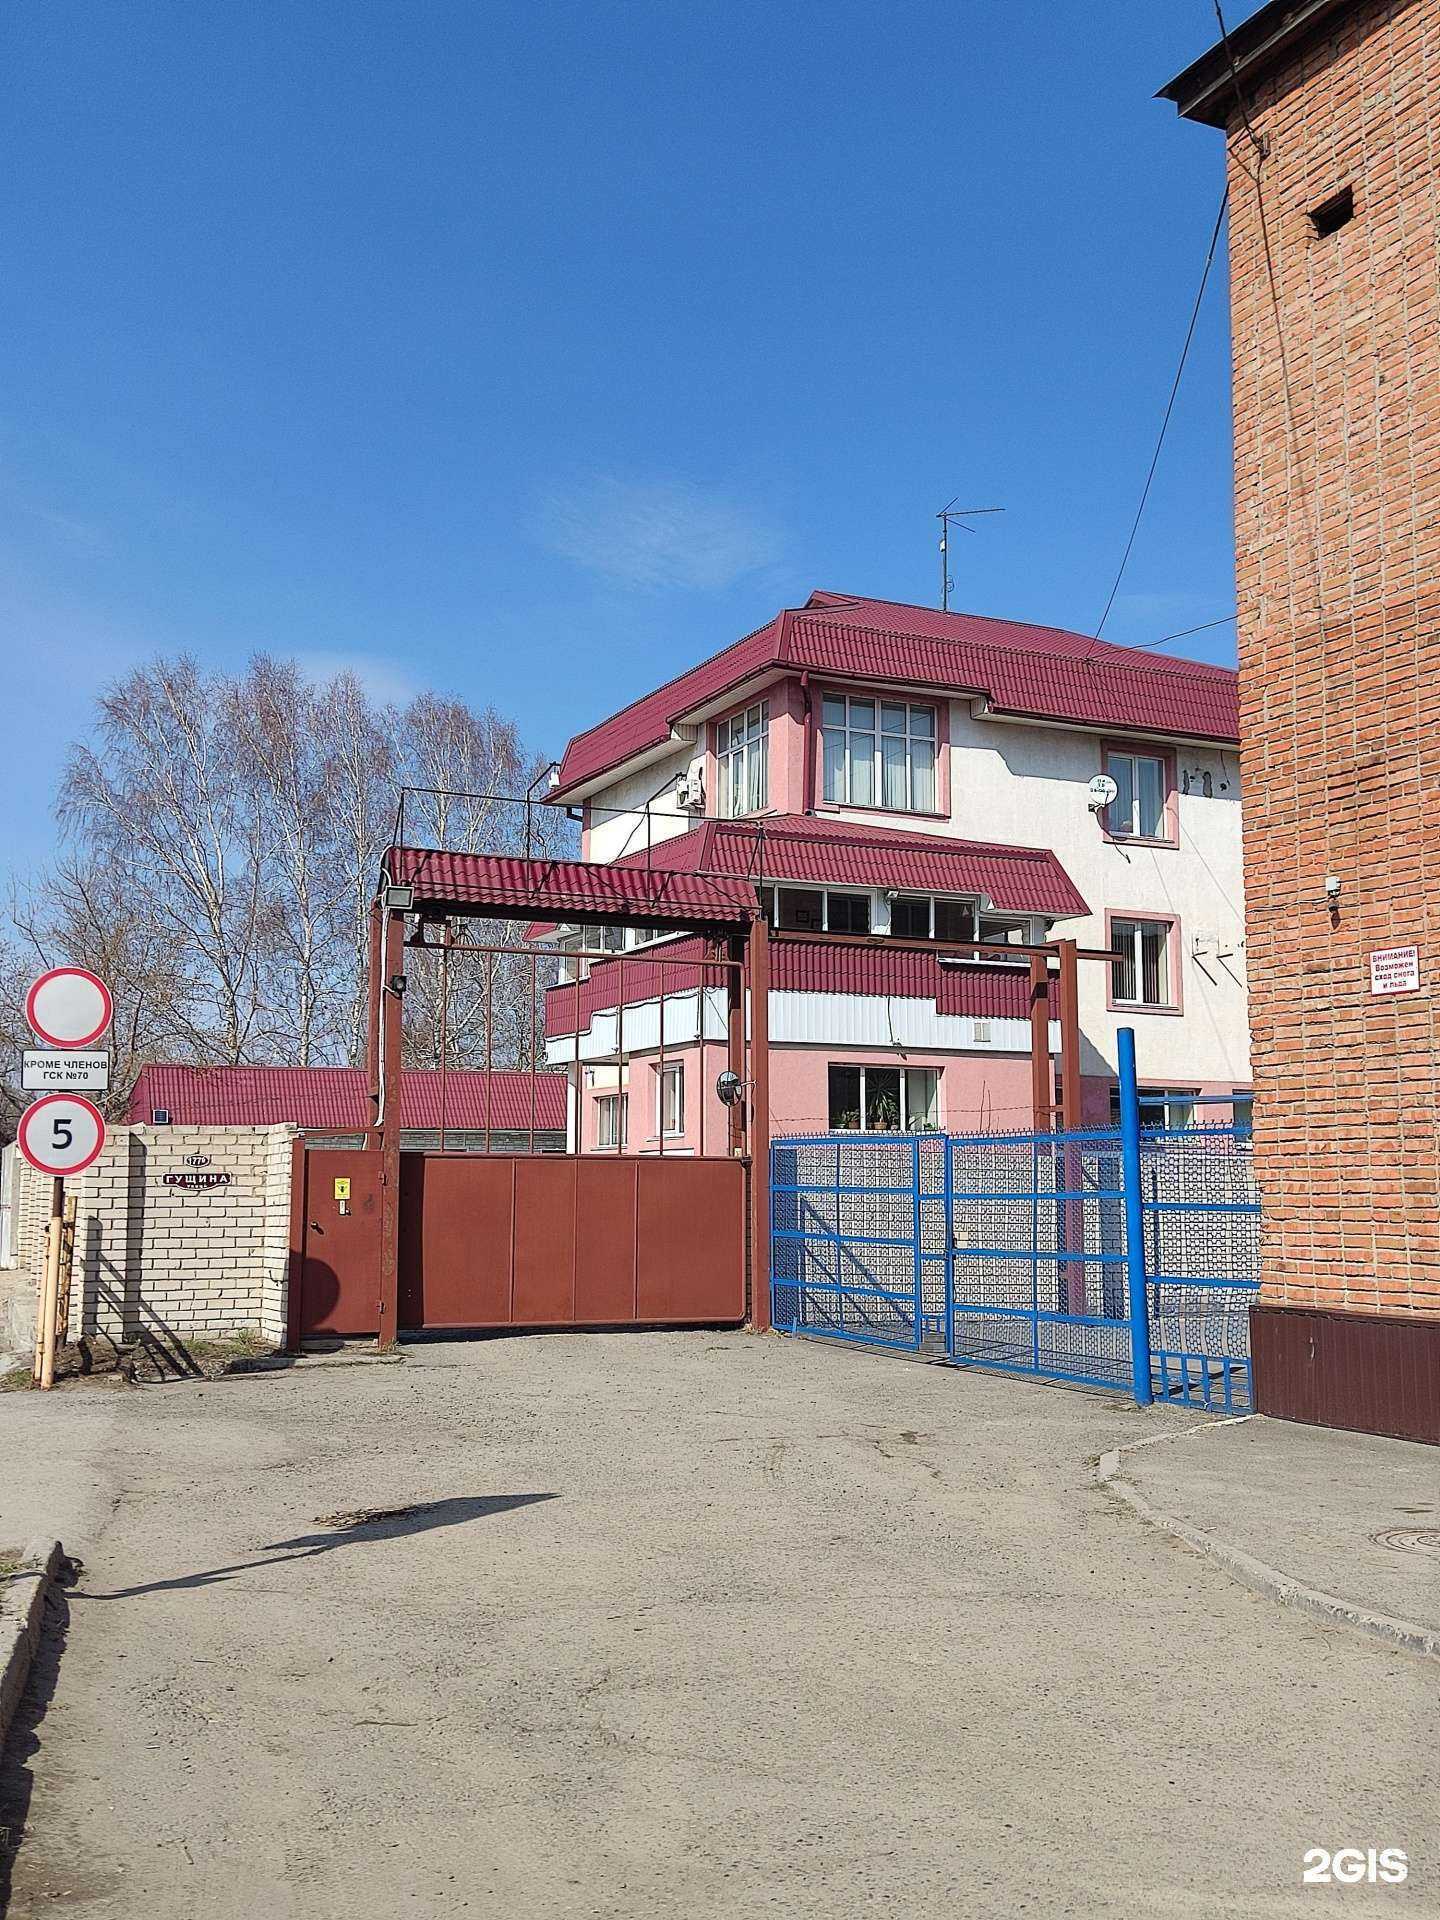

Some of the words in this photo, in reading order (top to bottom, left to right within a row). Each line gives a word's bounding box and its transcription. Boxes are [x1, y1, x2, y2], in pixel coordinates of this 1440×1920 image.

[1372, 949, 1415, 962] ВНИМАНИЕ!
[24, 1060, 61, 1069] КРОМЕ
[64, 1060, 107, 1069] ЧЛЕНОВ
[43, 1071, 64, 1080] ГСК
[66, 1071, 89, 1080] №70
[51, 1118, 73, 1150] 5
[166, 1174, 228, 1184] ГУЩИНА
